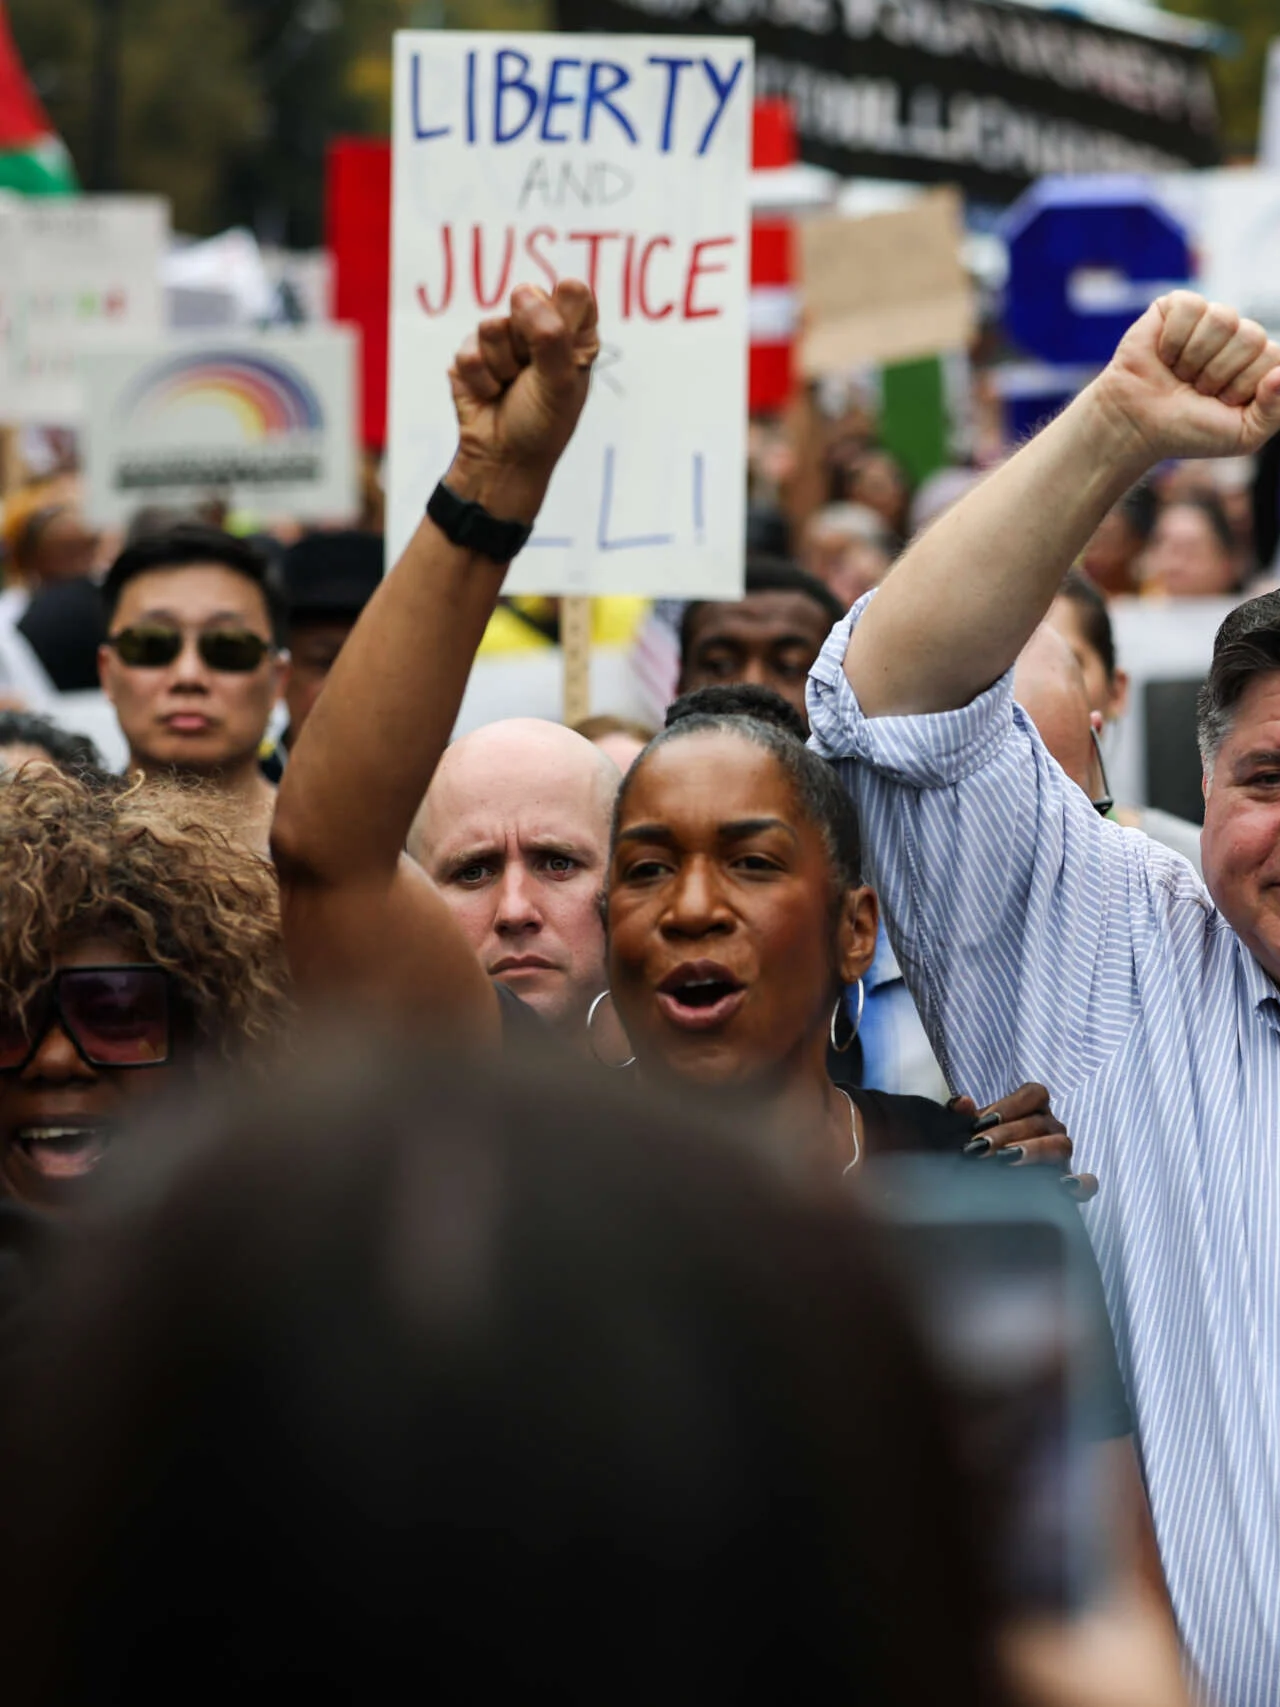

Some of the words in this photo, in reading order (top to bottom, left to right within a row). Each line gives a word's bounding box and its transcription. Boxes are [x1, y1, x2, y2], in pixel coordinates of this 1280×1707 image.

[411, 49, 745, 157] LIBERTY
[518, 156, 635, 211] AND
[416, 223, 736, 323] JUSTICE
